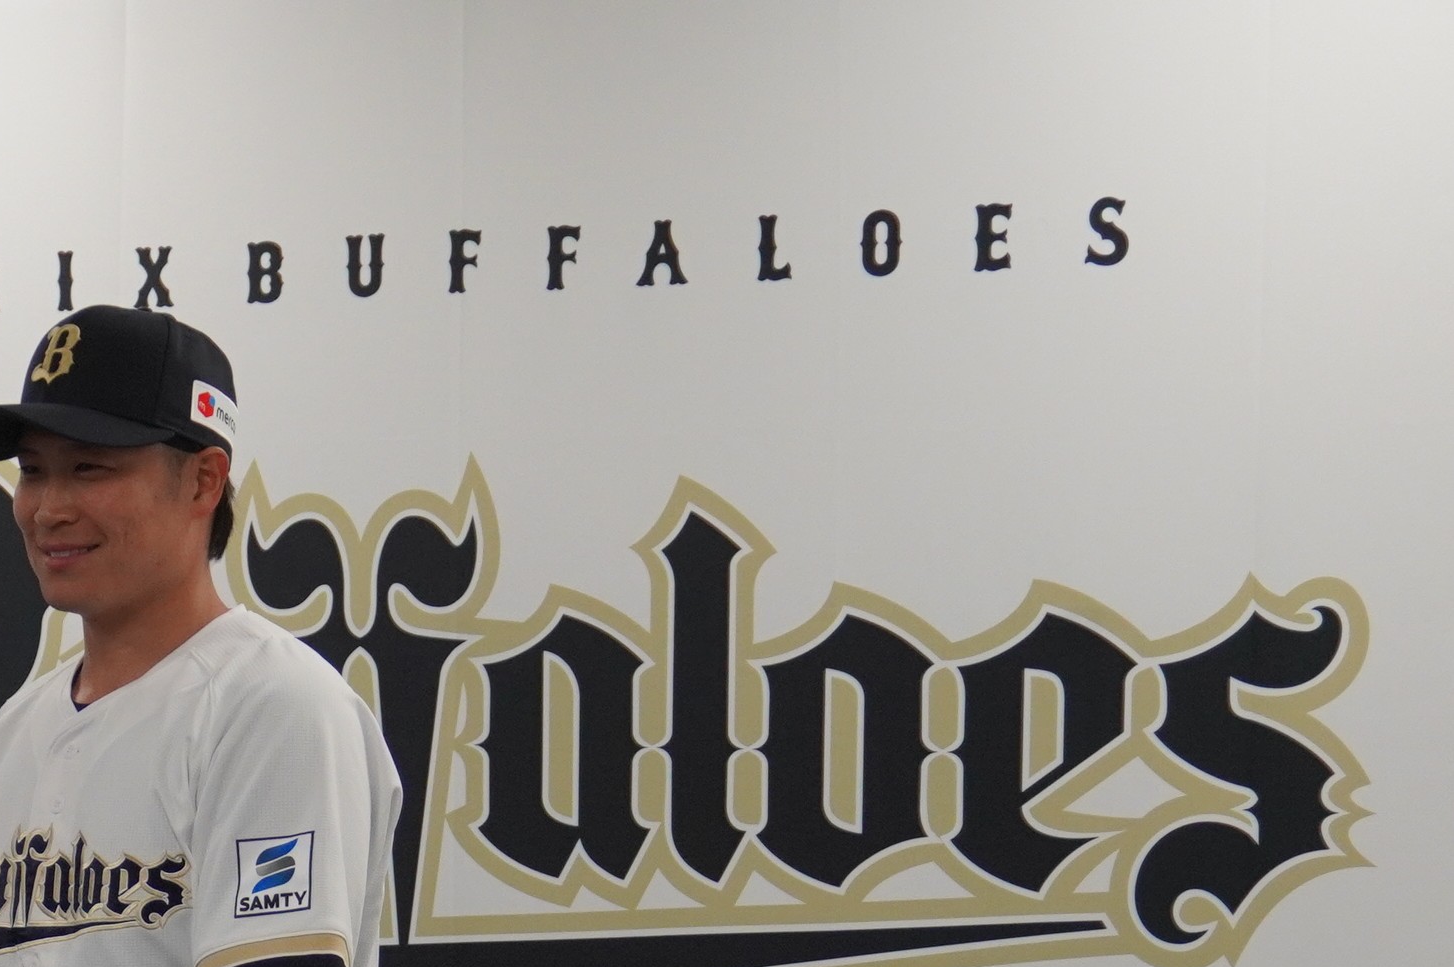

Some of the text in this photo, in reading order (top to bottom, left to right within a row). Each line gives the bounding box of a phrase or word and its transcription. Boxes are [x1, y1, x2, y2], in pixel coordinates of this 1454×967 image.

[245, 196, 1130, 304] BUFFALOES
[31, 323, 82, 384] B
[239, 890, 307, 912] SAMTY
